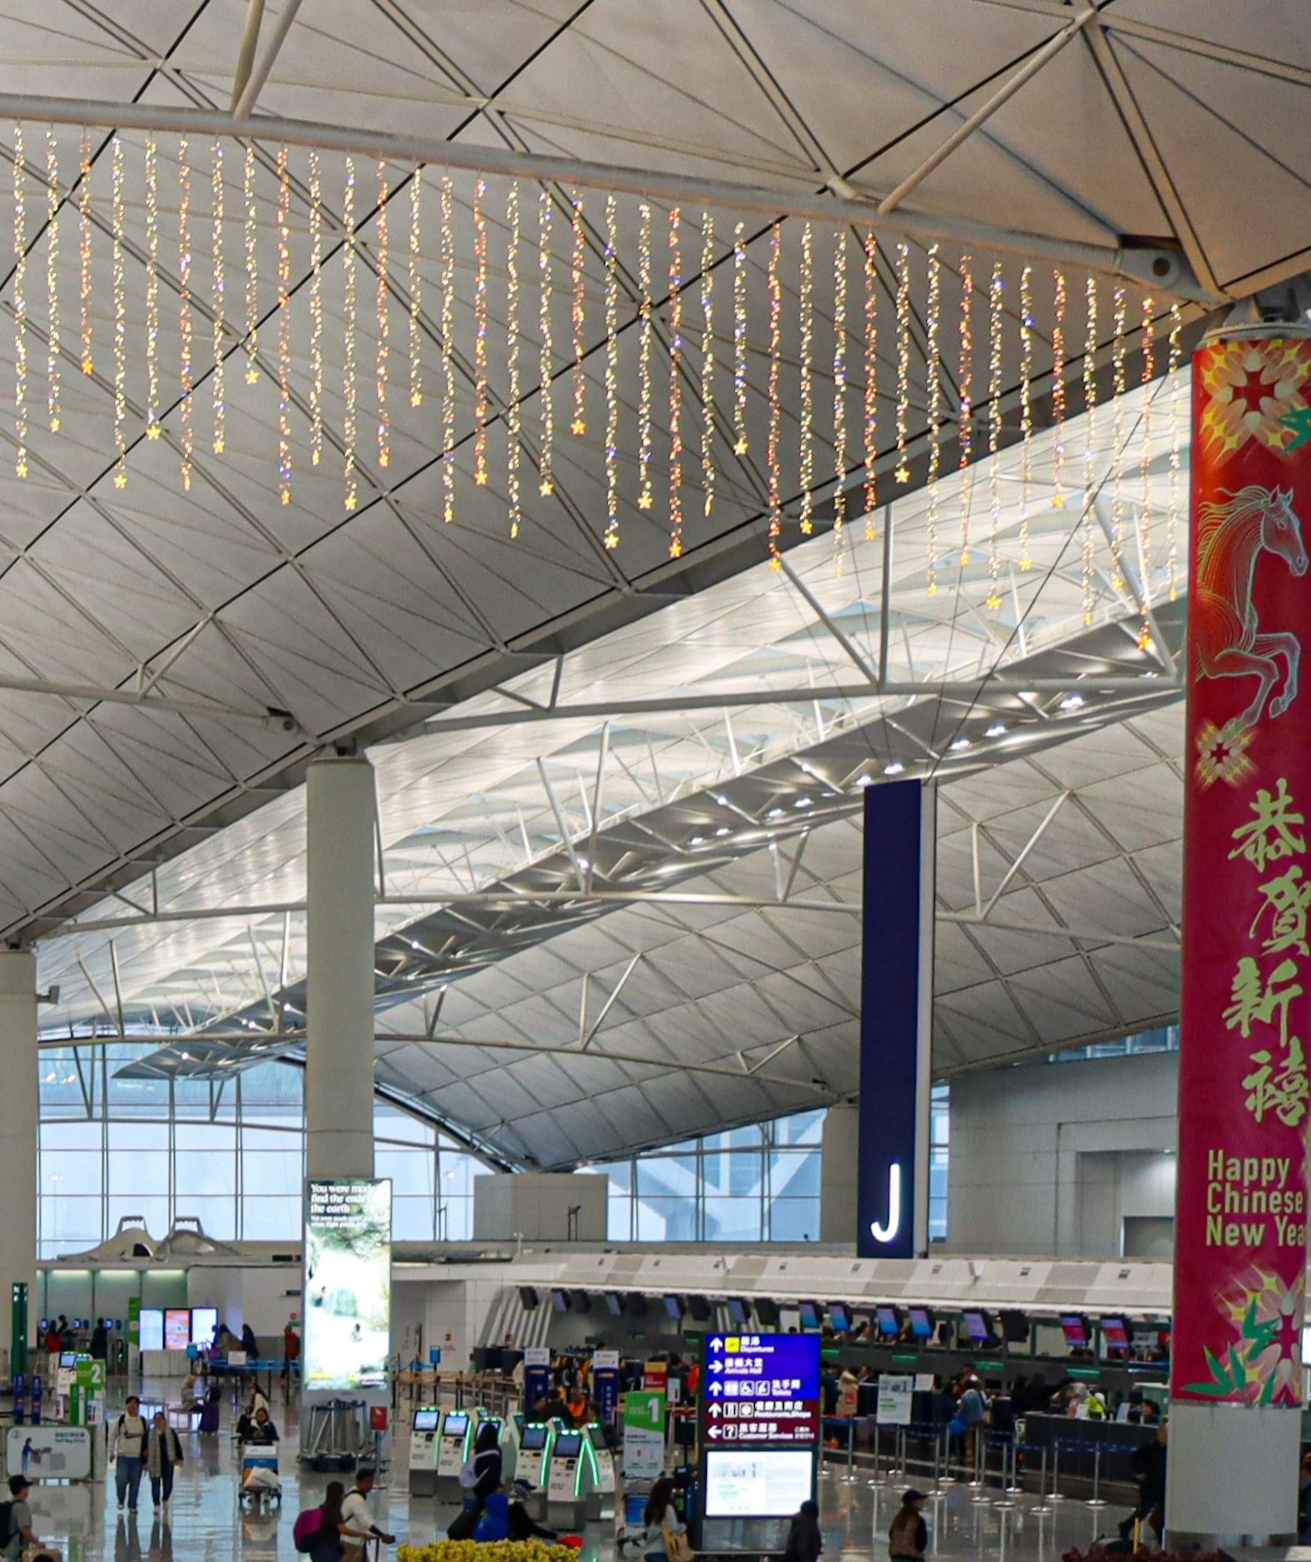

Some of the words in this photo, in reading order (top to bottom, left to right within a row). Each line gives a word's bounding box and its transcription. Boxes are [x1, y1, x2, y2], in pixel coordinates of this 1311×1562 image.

[1207, 1149, 1291, 1188] Happy
[311, 1184, 327, 1193] You
[329, 1185, 349, 1193] were
[311, 1194, 328, 1203] find
[330, 1194, 344, 1203] the
[1207, 1182, 1304, 1214] Chinese
[311, 1203, 325, 1213] the
[326, 1203, 350, 1213] earth
[870, 1163, 901, 1243] J
[1205, 1215, 1266, 1247] New
[91, 1364, 101, 1383] 2
[647, 1398, 660, 1423] 1
